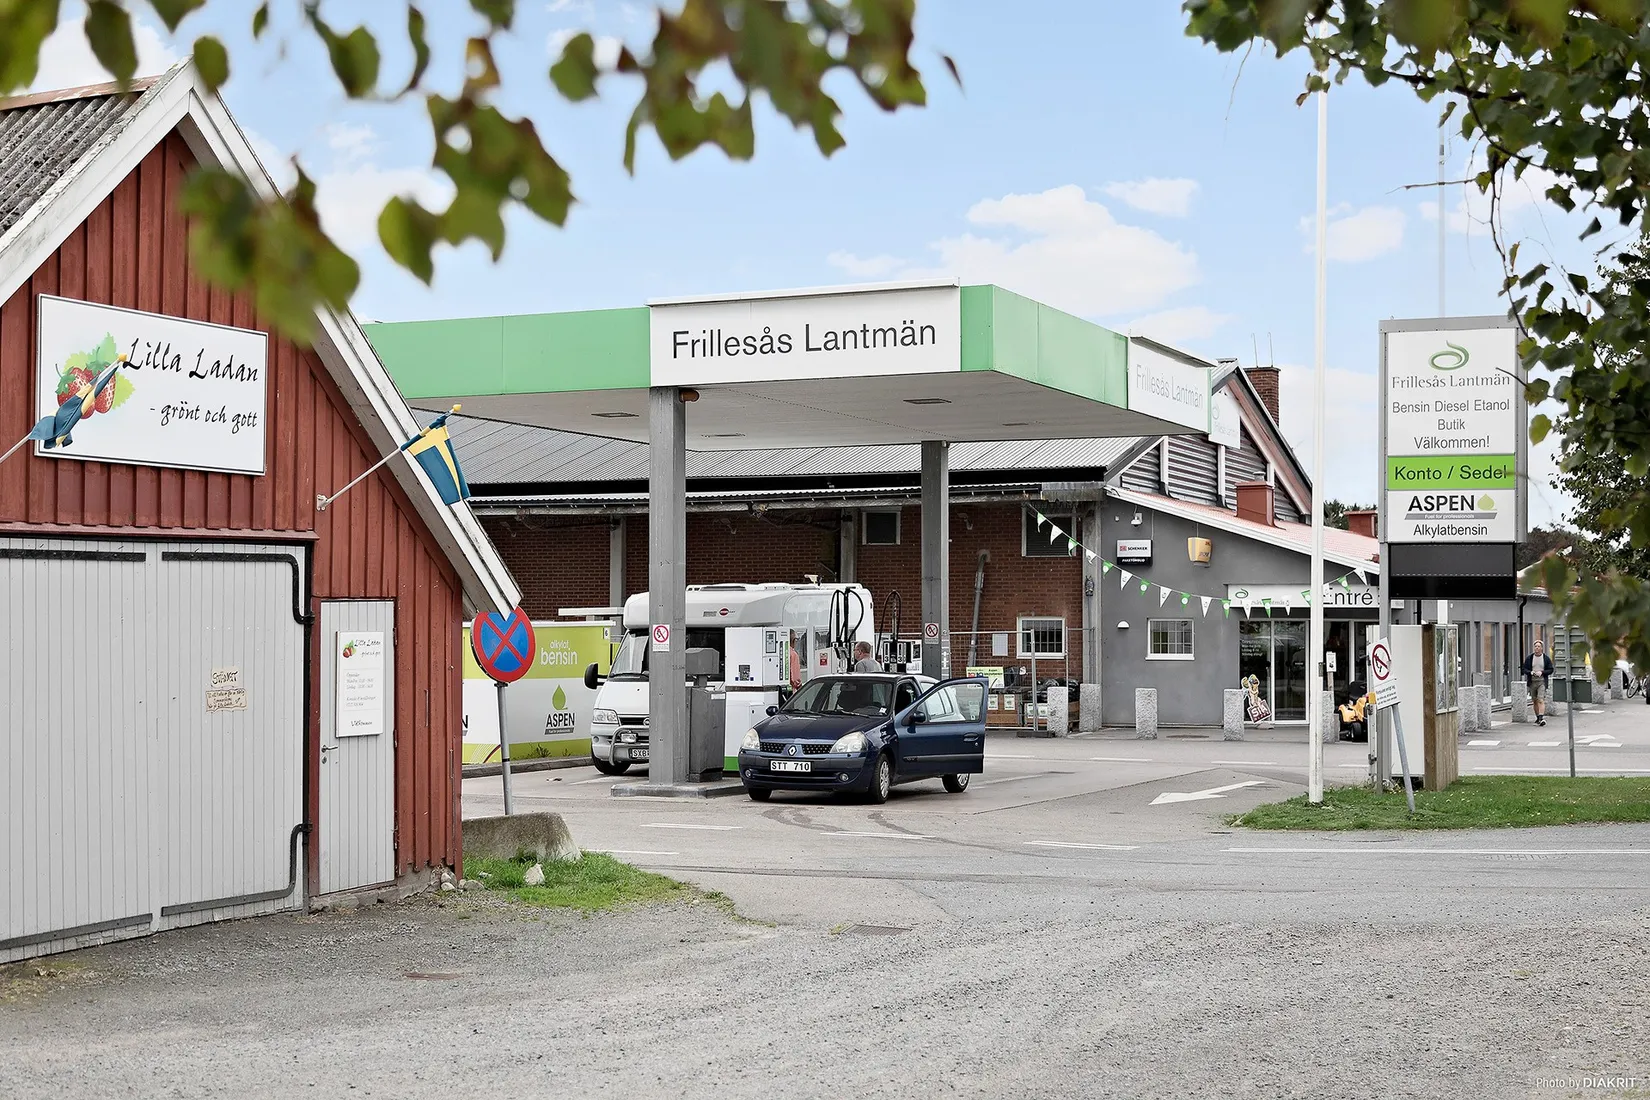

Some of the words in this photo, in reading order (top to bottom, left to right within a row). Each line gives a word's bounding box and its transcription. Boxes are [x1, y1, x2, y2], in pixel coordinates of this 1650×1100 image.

[672, 324, 793, 359] Frillesås
[804, 320, 937, 353] Lantmän
[123, 337, 183, 371] Lilla
[188, 347, 260, 383] Ladan
[1136, 364, 1170, 399] Frillesås
[1171, 375, 1204, 410] Lantmän
[1392, 374, 1447, 389] Frillesås
[1449, 373, 1511, 388] Lantmän
[1392, 401, 1430, 413] Bensin
[1434, 399, 1470, 412] Diesel
[1473, 398, 1511, 412] Etanol
[160, 400, 201, 427] grönt
[204, 404, 227, 424] och
[231, 409, 259, 434] gott
[1437, 418, 1466, 431] Butik
[1413, 435, 1491, 450] Välkommen!
[1394, 465, 1443, 481] Konto
[1447, 465, 1455, 480] /
[1459, 464, 1508, 480] Sedel
[1407, 494, 1476, 512] ASPEN
[1443, 512, 1475, 520] professionals
[1413, 523, 1488, 538] Alkylatbensin
[540, 647, 578, 666] bensin
[546, 712, 576, 728] ASPEN
[771, 762, 788, 771] STT
[794, 762, 810, 771] 710
